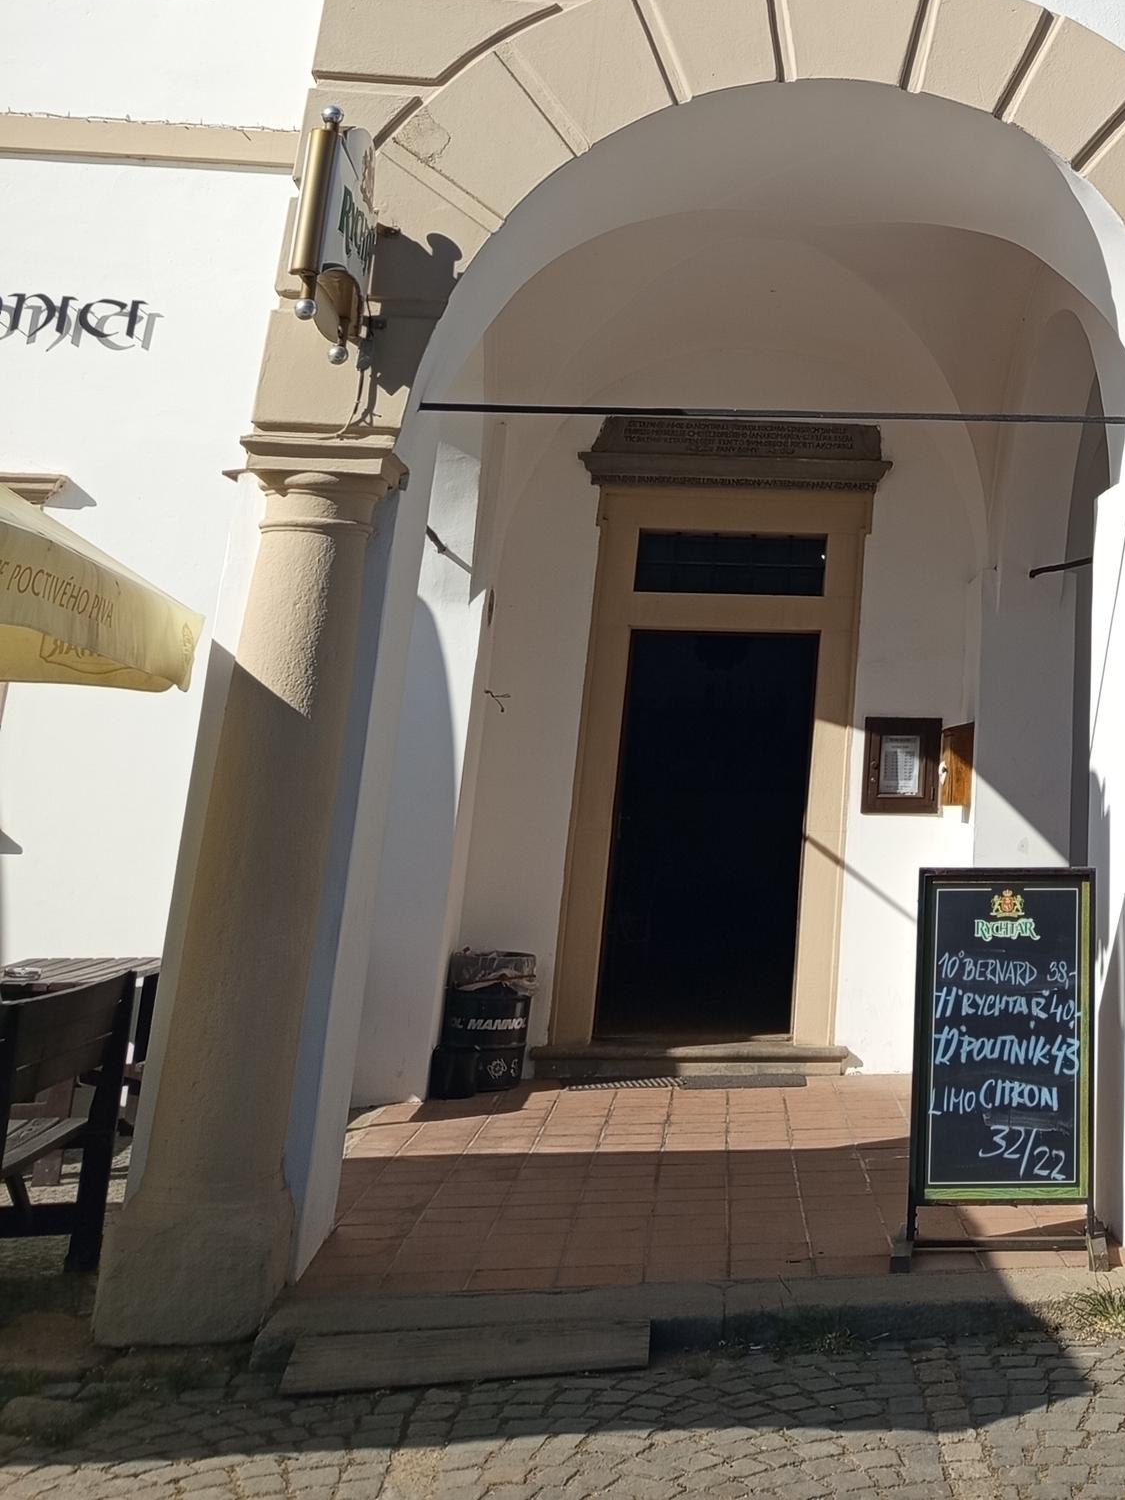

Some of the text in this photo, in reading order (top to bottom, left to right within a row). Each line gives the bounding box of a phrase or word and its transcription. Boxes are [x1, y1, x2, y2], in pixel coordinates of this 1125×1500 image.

[0, 293, 149, 339] NICI
[6, 564, 114, 629] POCTIVÉHO PIVA
[962, 958, 1037, 986] BERNARD
